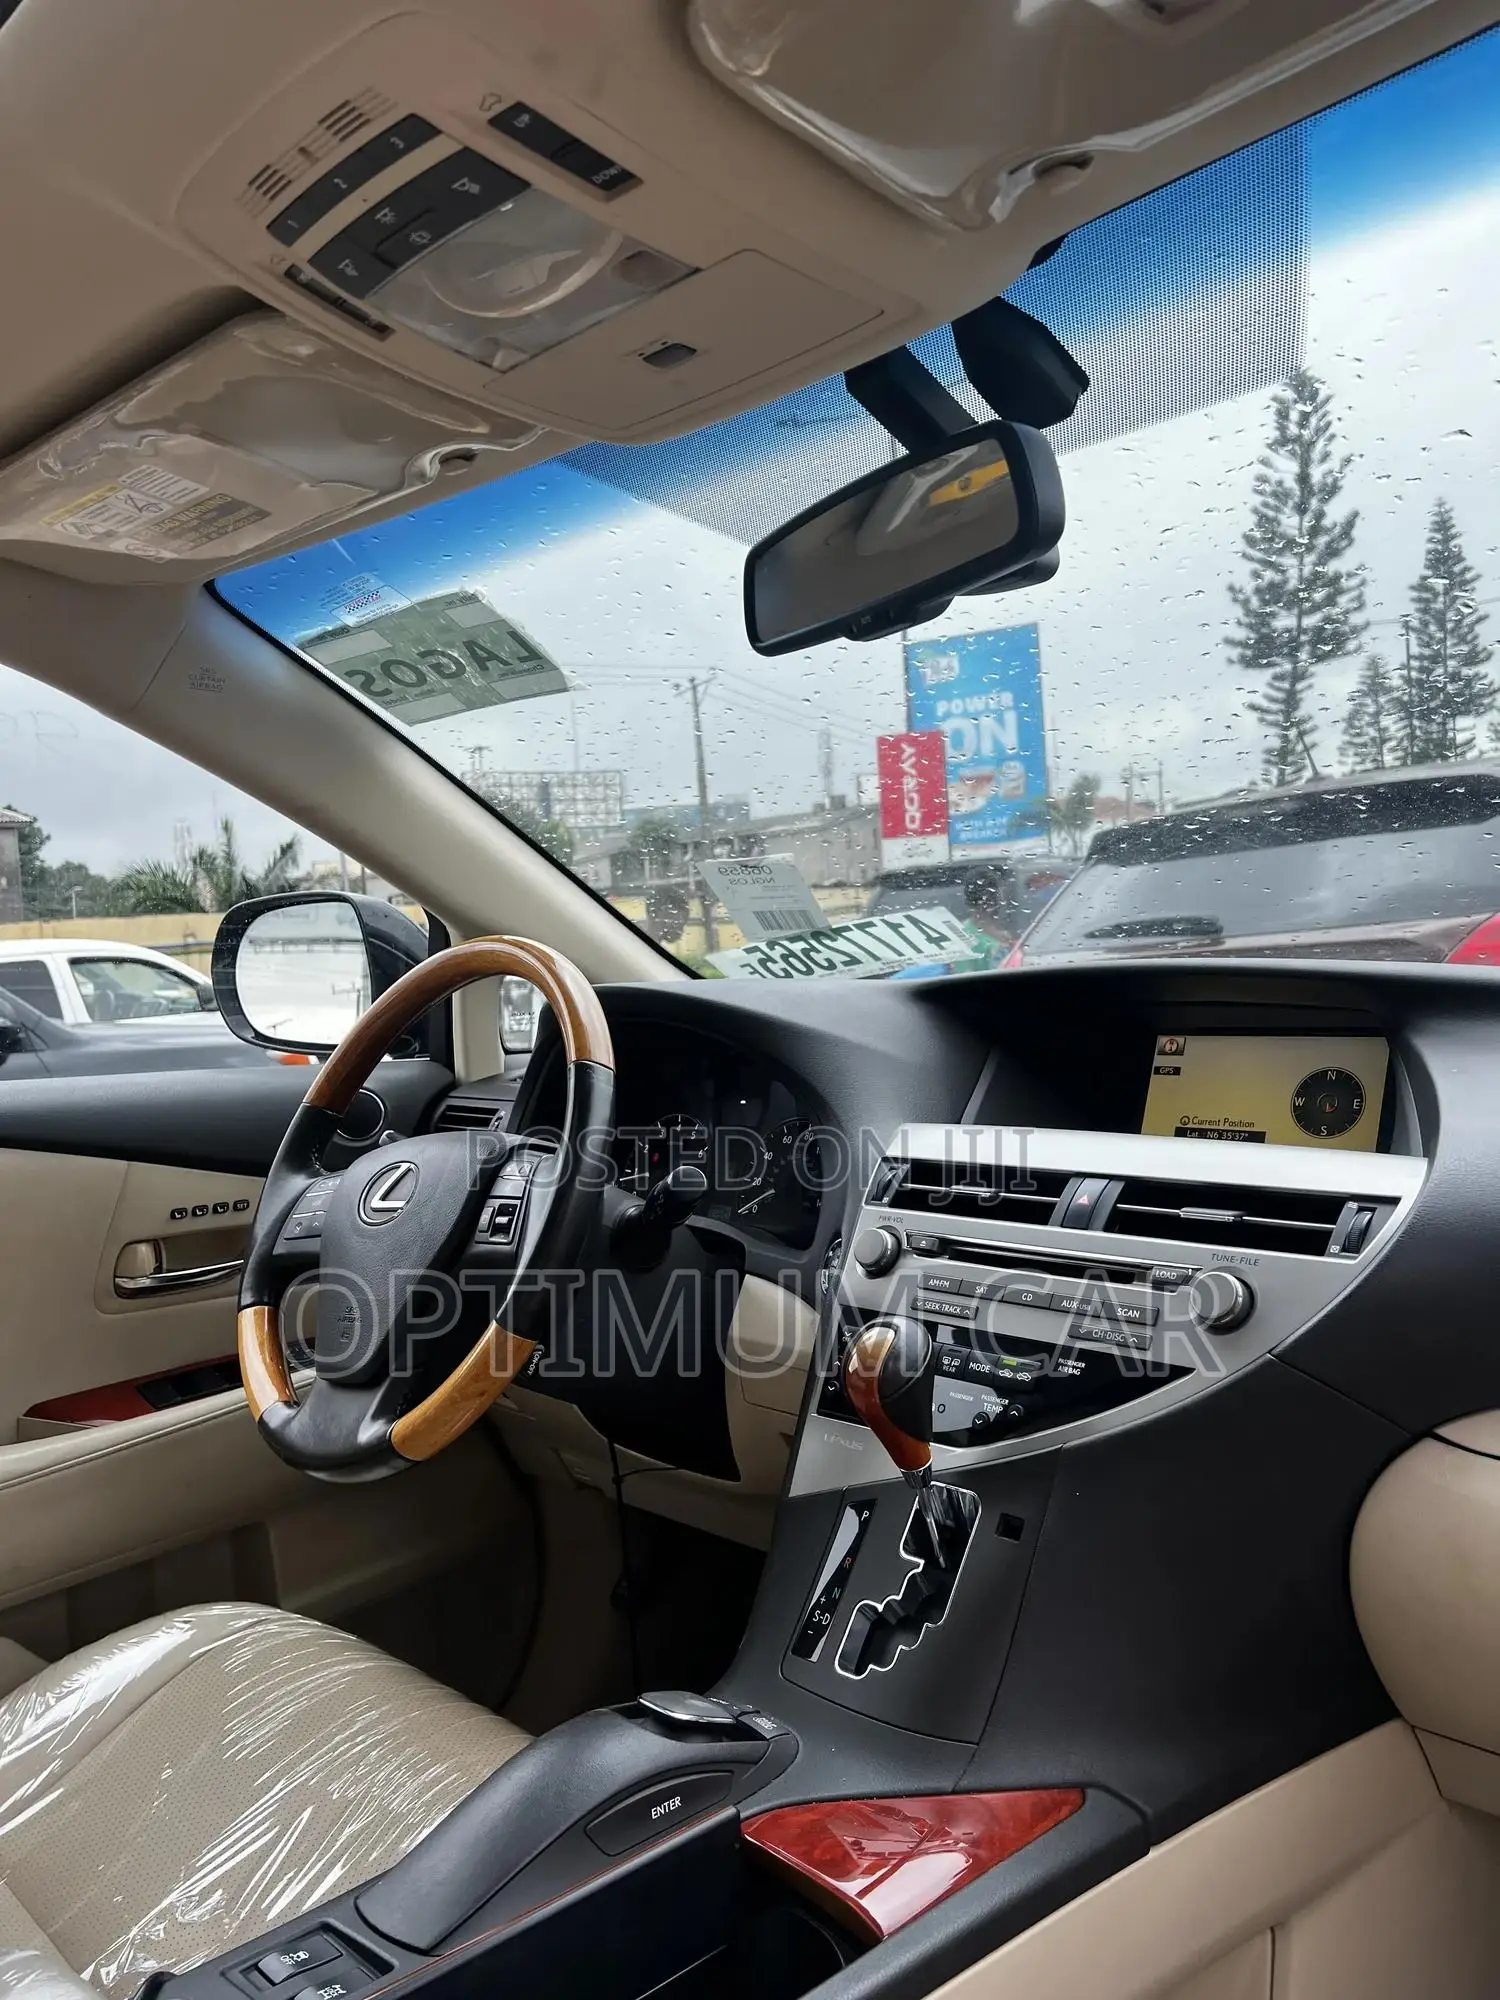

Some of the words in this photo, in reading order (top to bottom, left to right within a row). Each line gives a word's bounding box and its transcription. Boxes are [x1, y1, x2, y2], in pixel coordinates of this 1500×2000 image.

[513, 113, 532, 128] UP
[390, 136, 405, 150] 3
[334, 177, 348, 190] 2
[937, 691, 1014, 716] POWER
[941, 710, 1018, 763] ON
[1327, 1071, 1336, 1081] N
[1294, 1097, 1305, 1107] W
[1353, 1099, 1361, 1109] E
[1191, 1116, 1220, 1126] Current
[1223, 1117, 1255, 1128] Position
[690, 1131, 697, 1140] 5
[1320, 1126, 1328, 1136] S
[782, 1135, 793, 1145] 60
[763, 1151, 774, 1161] 40
[752, 1177, 762, 1187] 20
[752, 1204, 758, 1214] 0
[1155, 1269, 1178, 1280] LOAD
[975, 1285, 988, 1295] SAT
[1021, 1292, 1033, 1302] CD
[1117, 1307, 1140, 1319] SCAN
[942, 1365, 956, 1374] REAR
[969, 1361, 991, 1374] MODE
[981, 1393, 1009, 1406] PASSENGER
[983, 1402, 1004, 1414] TEMP
[861, 1510, 870, 1521] P
[843, 1557, 851, 1568] R
[832, 1587, 841, 1599] N
[651, 1796, 682, 1820] ENTER
